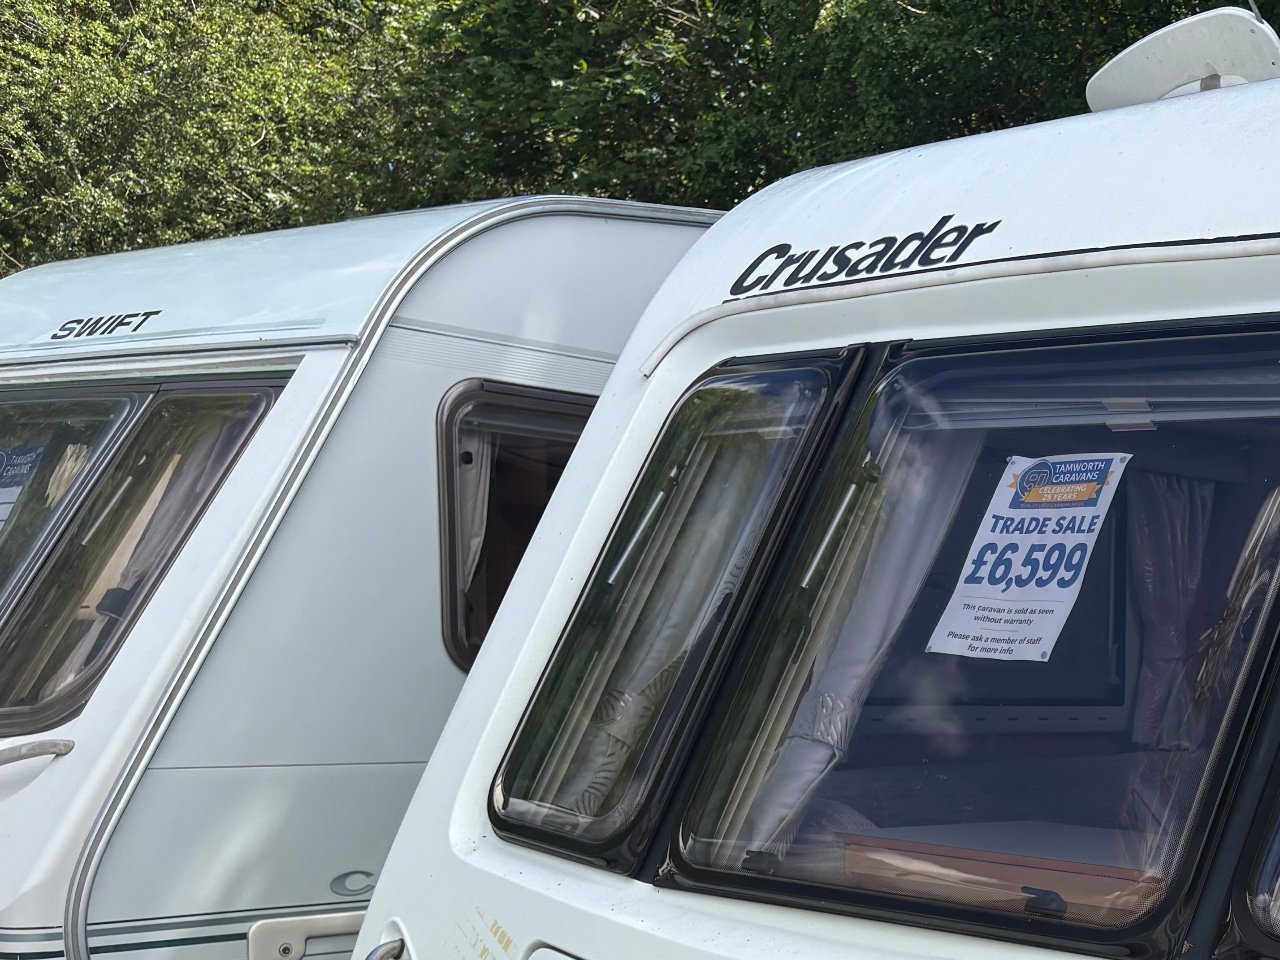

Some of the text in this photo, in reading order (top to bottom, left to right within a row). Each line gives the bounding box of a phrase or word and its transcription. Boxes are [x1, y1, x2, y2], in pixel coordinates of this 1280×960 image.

[729, 213, 1003, 296] Crusader
[50, 309, 163, 340] SWIFT
[1055, 461, 1106, 473] TAMWORTH
[1052, 471, 1100, 483] CARAVANS
[1039, 484, 1087, 494] CELEBRATING
[1053, 493, 1077, 501] YEARS
[990, 514, 1101, 535] TRADE SALE
[963, 542, 1088, 594] £6,599
[962, 603, 976, 611] This
[977, 605, 1006, 614] caravan
[1006, 607, 1013, 615] is
[1013, 607, 1028, 615] sold
[973, 615, 1034, 626] without warranty
[946, 631, 970, 640] Please
[990, 637, 1017, 645] member
[1026, 636, 1042, 645] staff
[967, 644, 1014, 655] for more info
